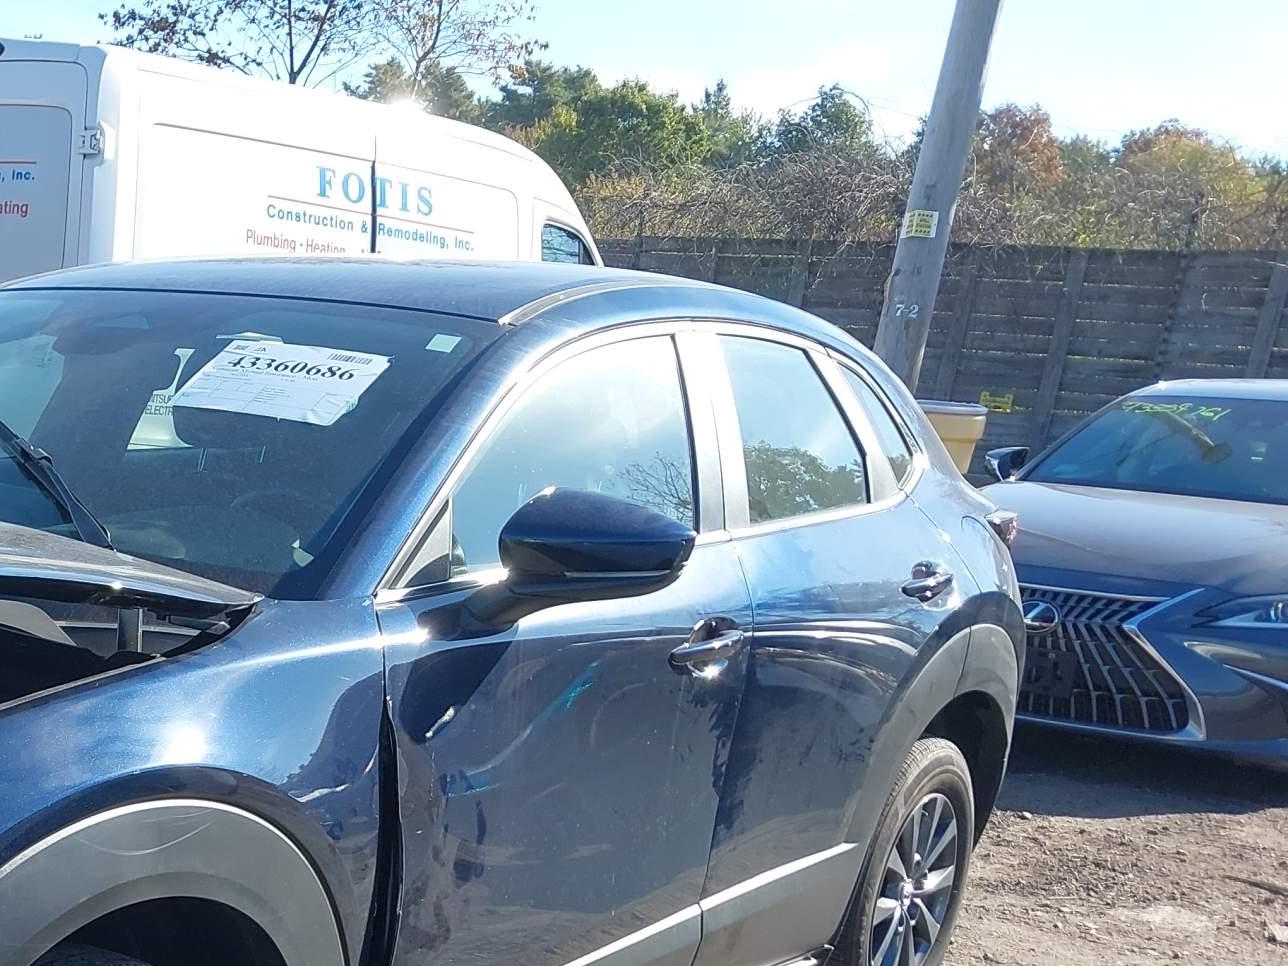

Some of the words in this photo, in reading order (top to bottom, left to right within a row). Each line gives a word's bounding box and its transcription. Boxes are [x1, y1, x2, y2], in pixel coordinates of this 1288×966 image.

[12, 169, 35, 181] Inc.
[316, 165, 434, 217] FOTIS
[246, 228, 297, 254] Plumbing
[266, 203, 354, 232] Construction
[360, 220, 368, 234] &
[378, 222, 449, 250] Remodeling,
[454, 235, 474, 252] Inc.
[895, 304, 920, 318] 7-2
[227, 354, 360, 382] 43360686
